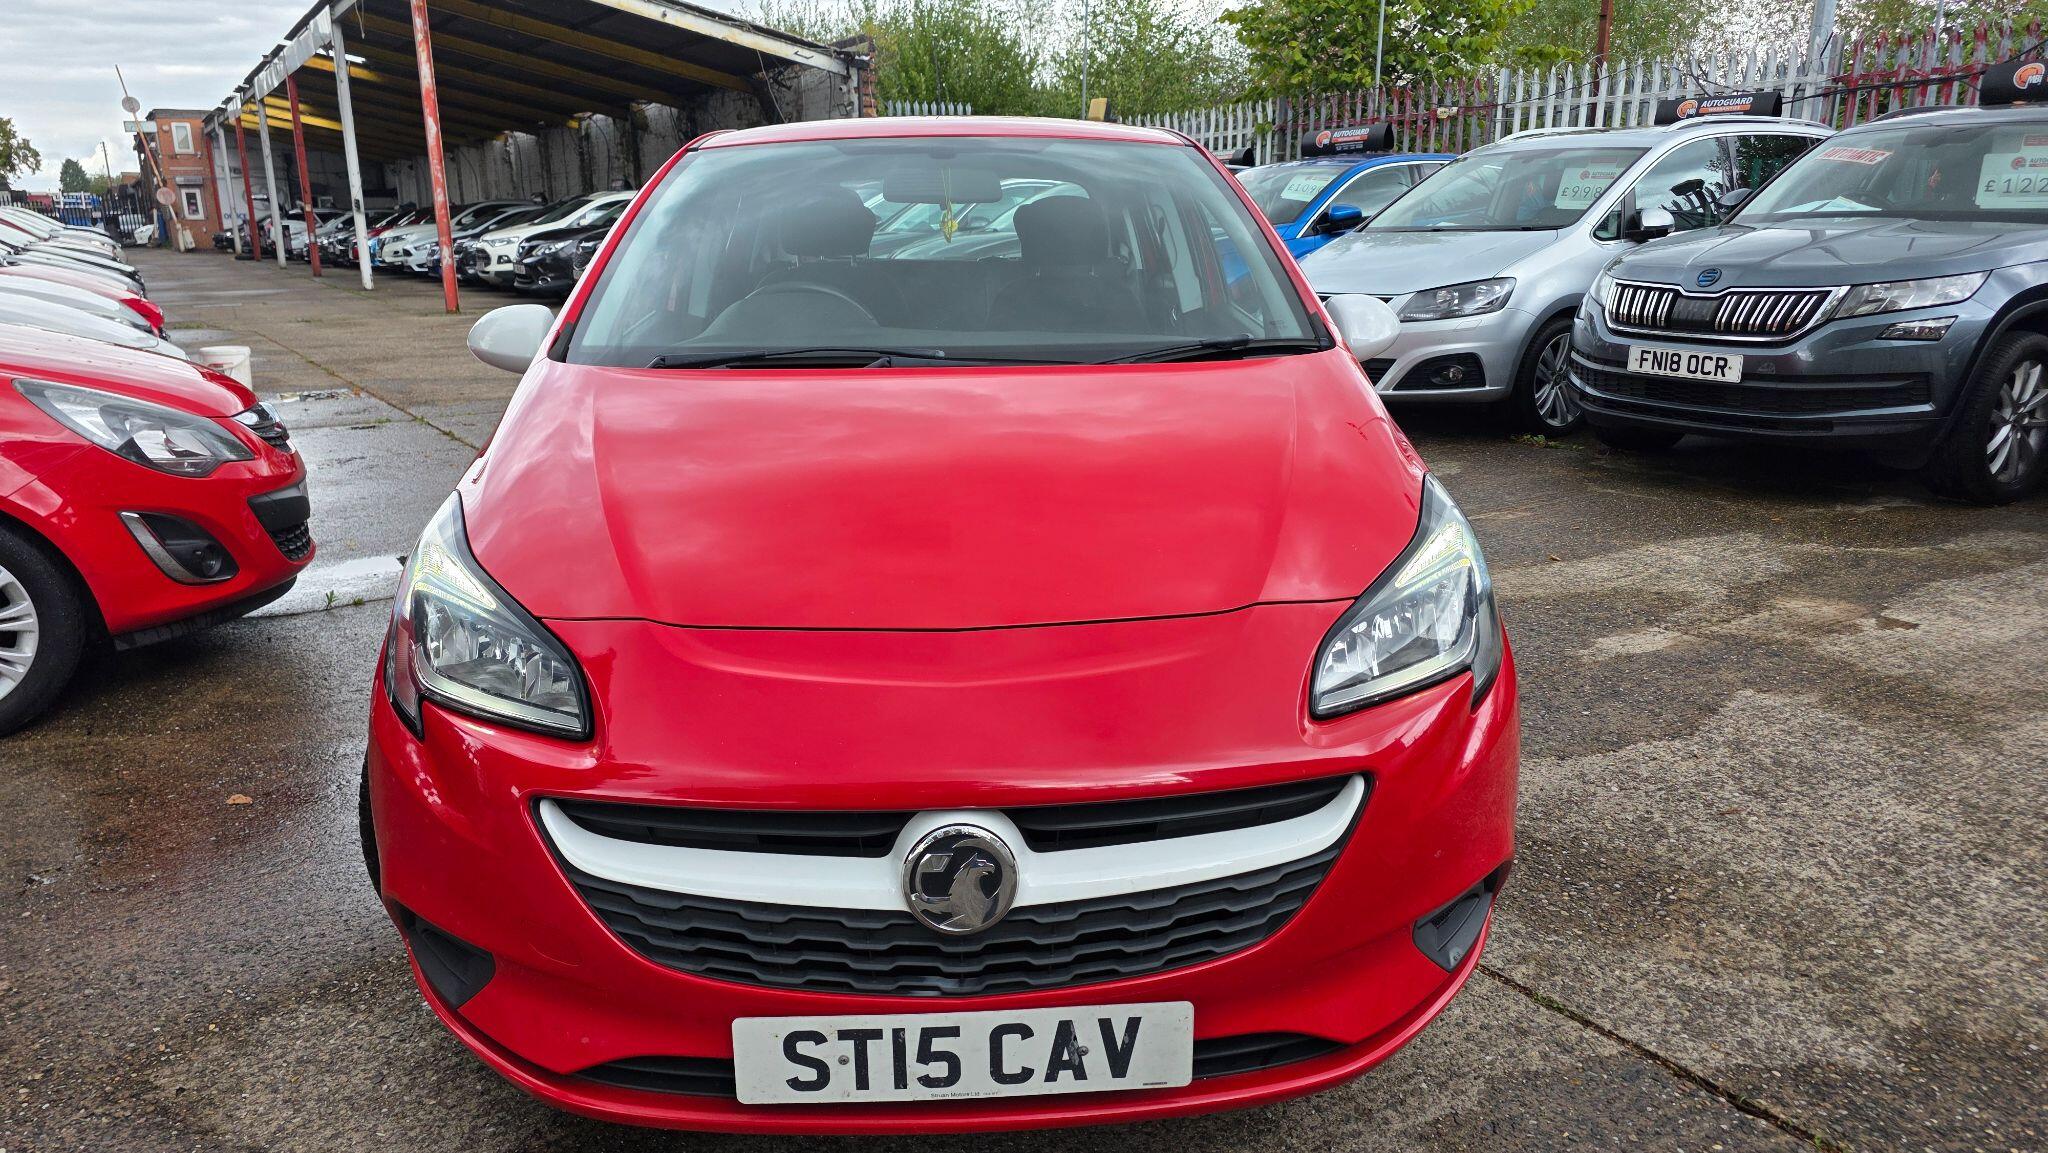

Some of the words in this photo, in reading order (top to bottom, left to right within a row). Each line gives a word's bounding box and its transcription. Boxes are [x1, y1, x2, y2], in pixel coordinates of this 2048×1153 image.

[1701, 97, 1753, 108] AUTOGUARD
[1333, 128, 1370, 138] AUTOGUARD
[1639, 349, 1682, 373] FN18
[1687, 354, 1728, 378] OCR
[782, 1025, 962, 1092] ST15
[988, 1016, 1142, 1085] CAV
